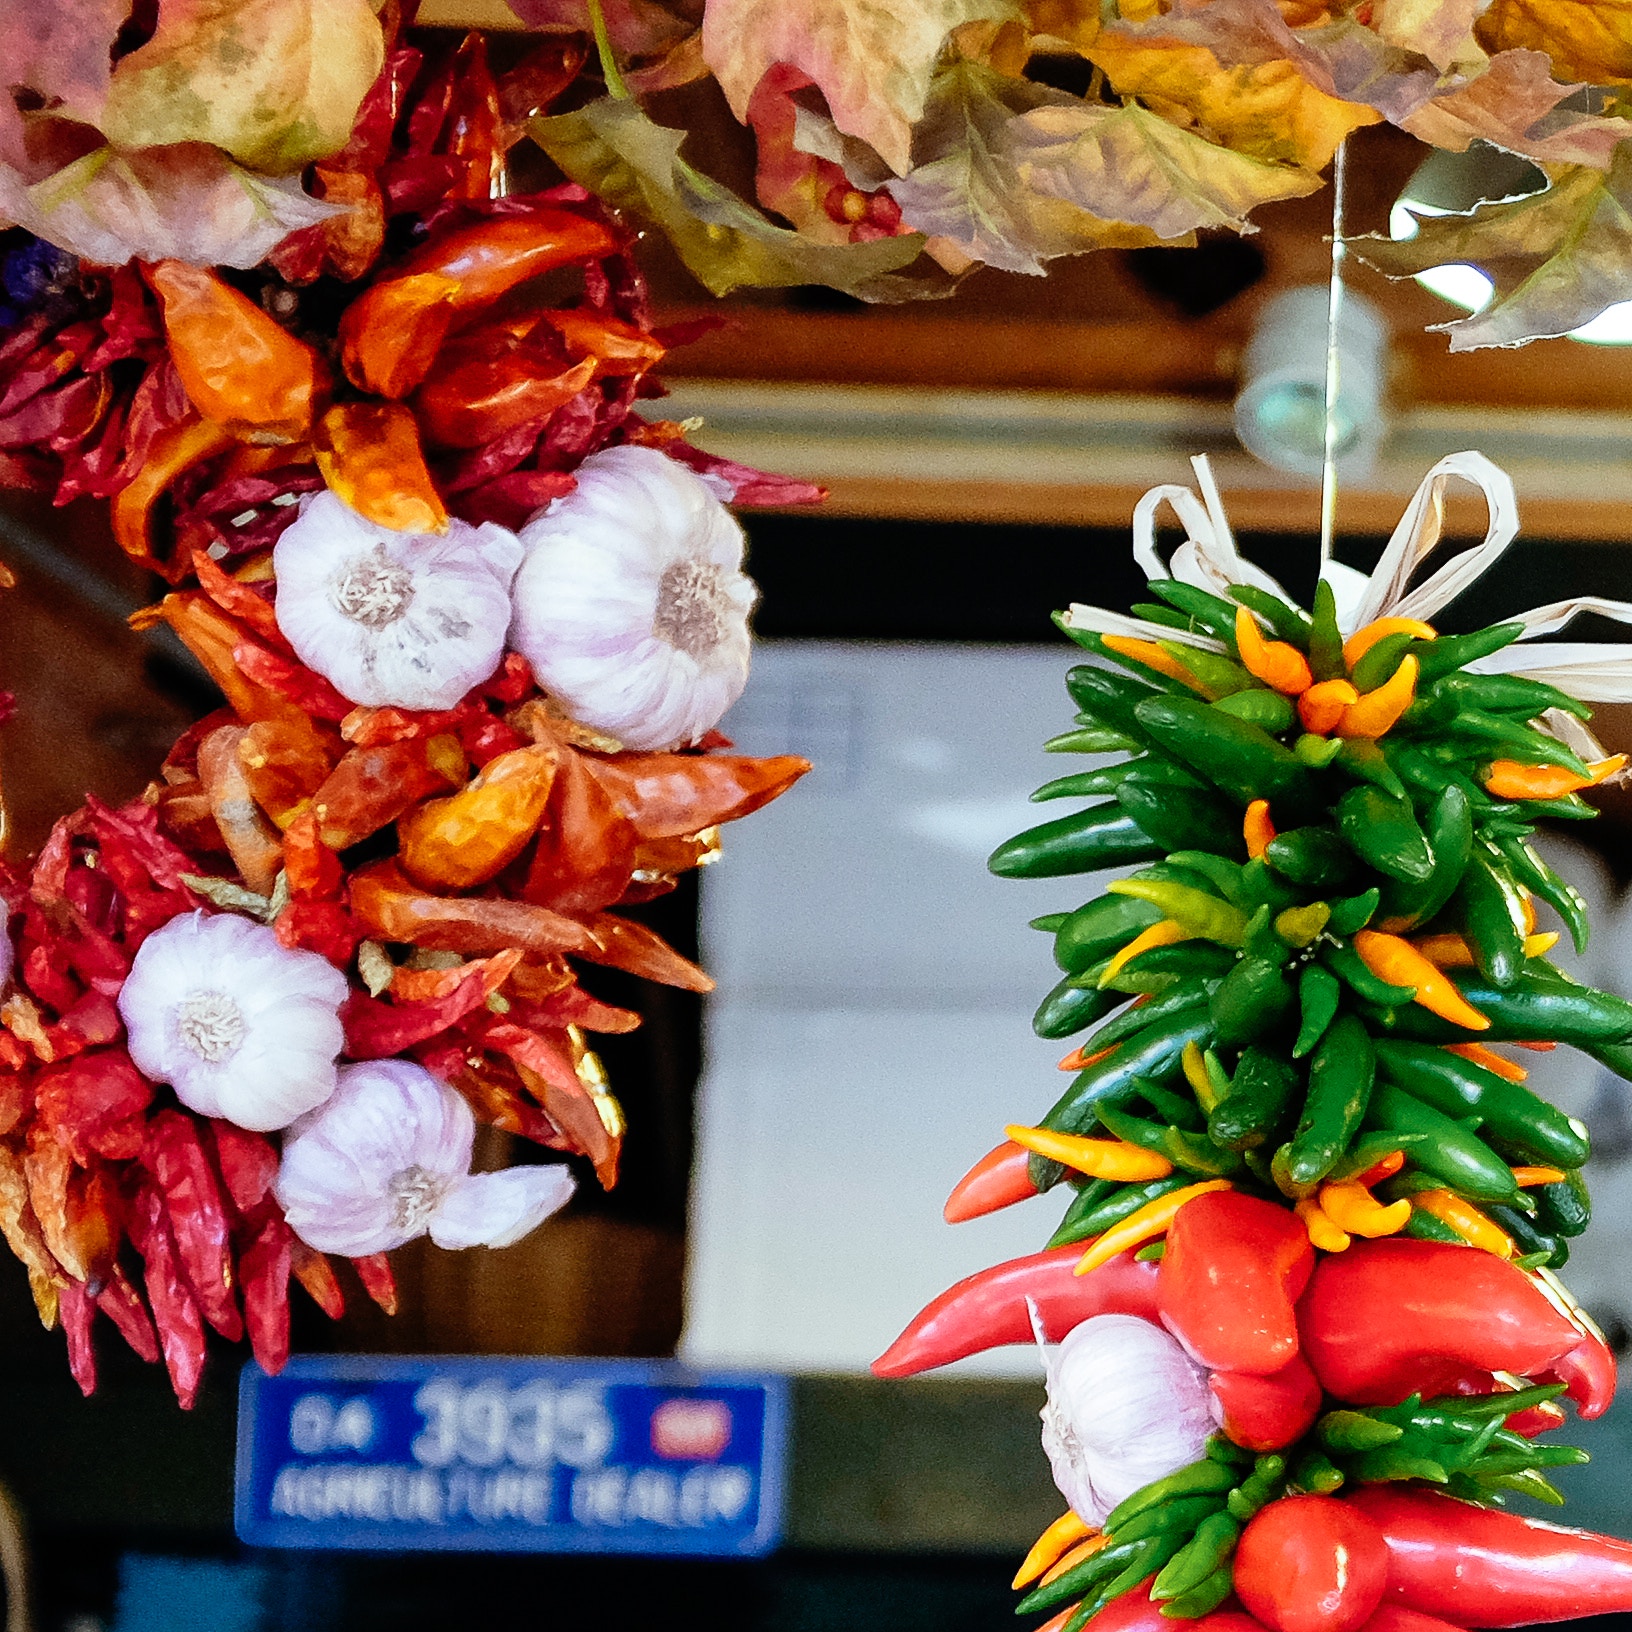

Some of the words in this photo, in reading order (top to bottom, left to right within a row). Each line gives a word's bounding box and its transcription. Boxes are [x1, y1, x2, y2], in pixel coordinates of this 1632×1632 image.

[411, 1377, 616, 1467] 3935
[271, 1465, 552, 1526] AGRICULTURE
[571, 1465, 753, 1528] DEALER
